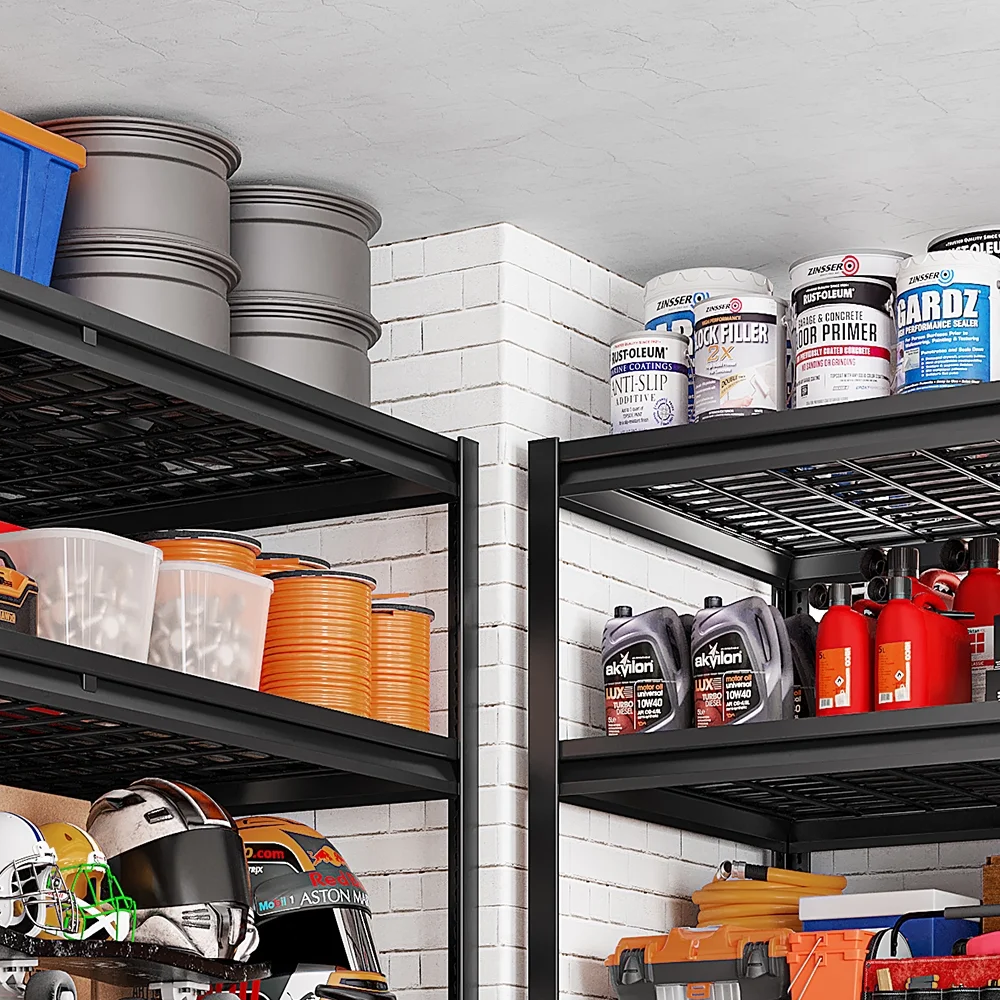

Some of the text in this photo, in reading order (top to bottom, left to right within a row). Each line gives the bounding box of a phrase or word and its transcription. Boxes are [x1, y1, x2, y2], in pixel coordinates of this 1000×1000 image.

[808, 263, 843, 276] ZINSSER
[909, 272, 940, 285] ZINSSER
[657, 295, 692, 311] ZINSSER
[803, 288, 853, 305] RUST-OLEUM
[705, 303, 731, 313] ZINSSER
[897, 288, 979, 328] GARDZ
[825, 311, 863, 321] CONCRETE
[720, 323, 769, 344] FILLER
[905, 320, 952, 334] PERFORMANCE
[953, 319, 979, 327] SEALER
[798, 323, 877, 348] OOR PRIMER
[612, 346, 666, 364] RUST-OLEUM
[707, 344, 735, 363] 2X
[823, 347, 843, 355] COATED
[611, 362, 673, 377] ARINE COATINGS
[616, 393, 656, 406] ADDITIVE
[695, 651, 743, 669] akvilon
[605, 660, 654, 678] akvilon
[695, 678, 713, 691] LUX
[605, 686, 625, 700] LUX
[726, 690, 751, 700] 10W40
[637, 698, 662, 708] 10W40
[308, 869, 348, 887] Red
[258, 895, 295, 911] Mobil 1
[300, 888, 351, 906] ASTON
